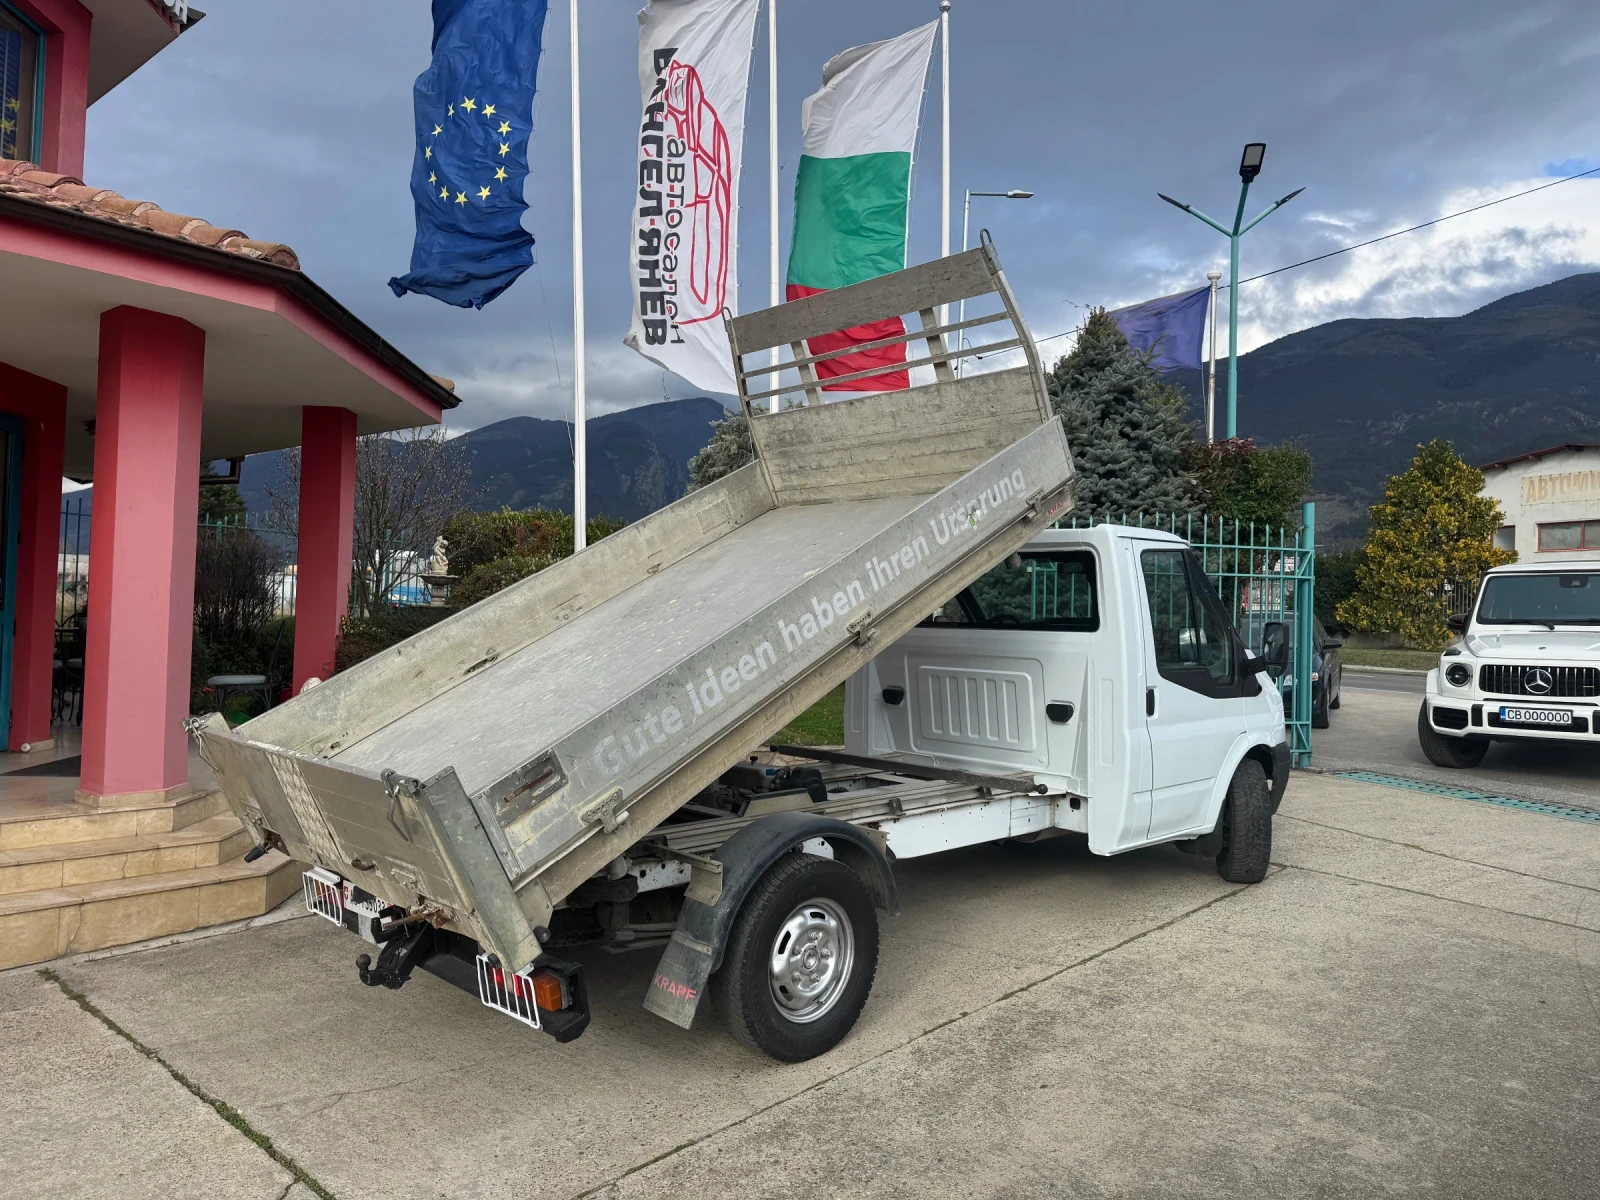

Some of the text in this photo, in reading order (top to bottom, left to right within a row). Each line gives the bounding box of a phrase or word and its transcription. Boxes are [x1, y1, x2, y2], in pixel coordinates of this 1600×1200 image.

[638, 228, 667, 346] ЯНЕВ
[594, 467, 1026, 776] Gute Ideen haben ihren Ursprung
[1507, 709, 1522, 720] CB
[1524, 711, 1569, 723] 000000
[653, 973, 697, 1001] KRAPF
